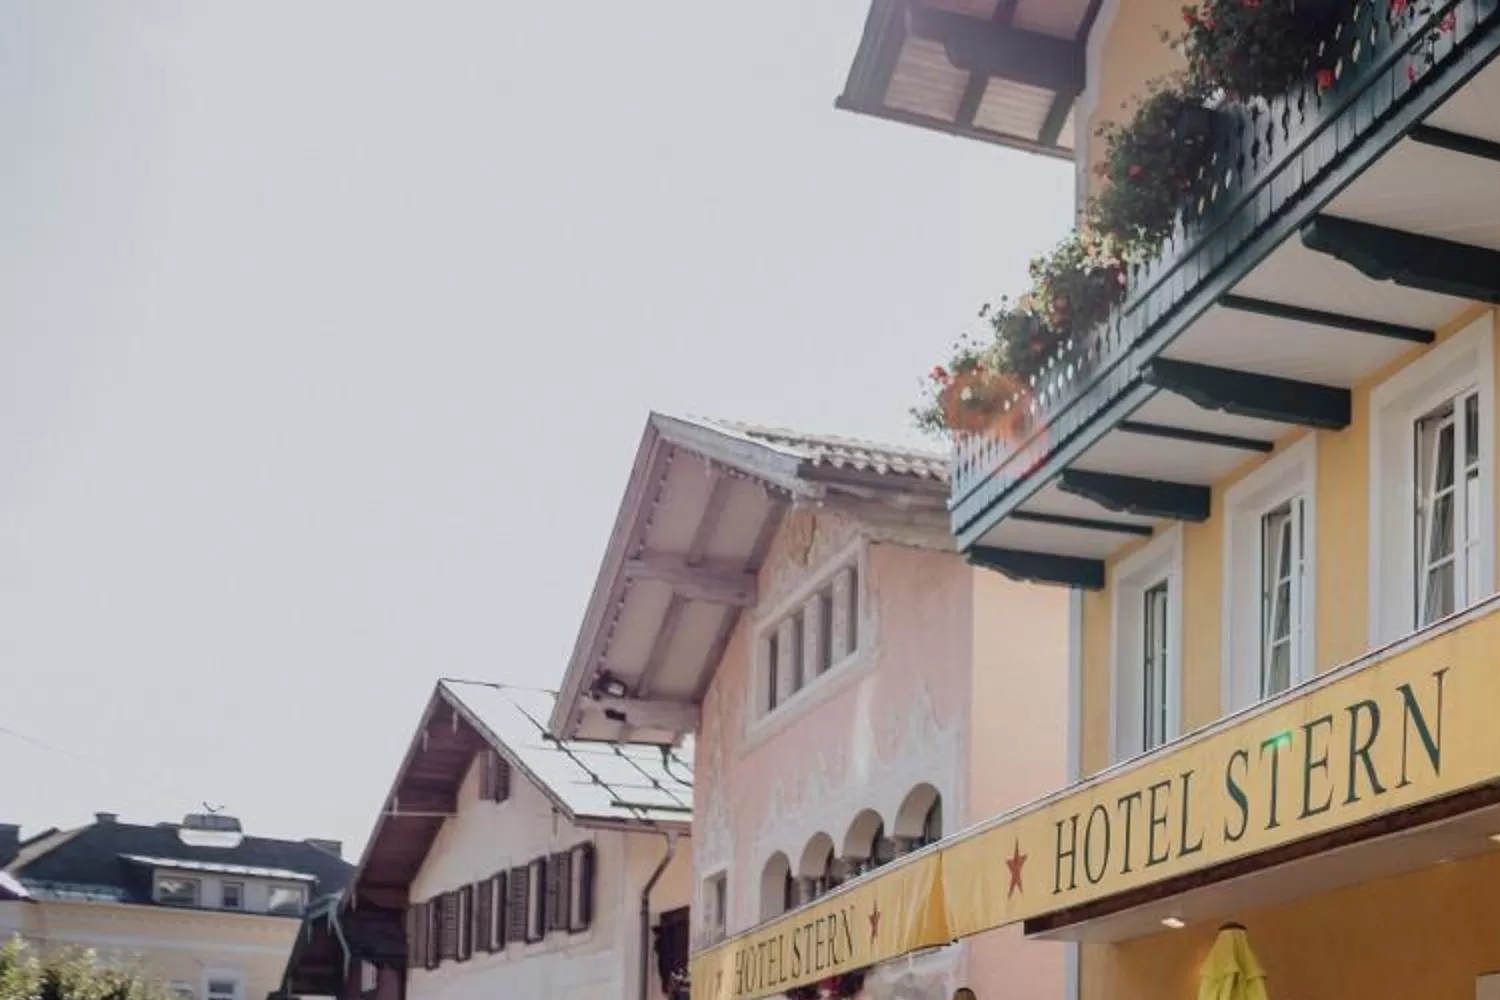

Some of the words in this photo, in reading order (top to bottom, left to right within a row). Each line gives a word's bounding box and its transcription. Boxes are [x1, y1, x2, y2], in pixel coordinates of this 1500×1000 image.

[1052, 769, 1205, 895] HOTEL
[1223, 667, 1450, 843] STERN
[735, 934, 788, 995] HOTEL
[791, 904, 856, 979] STERN
